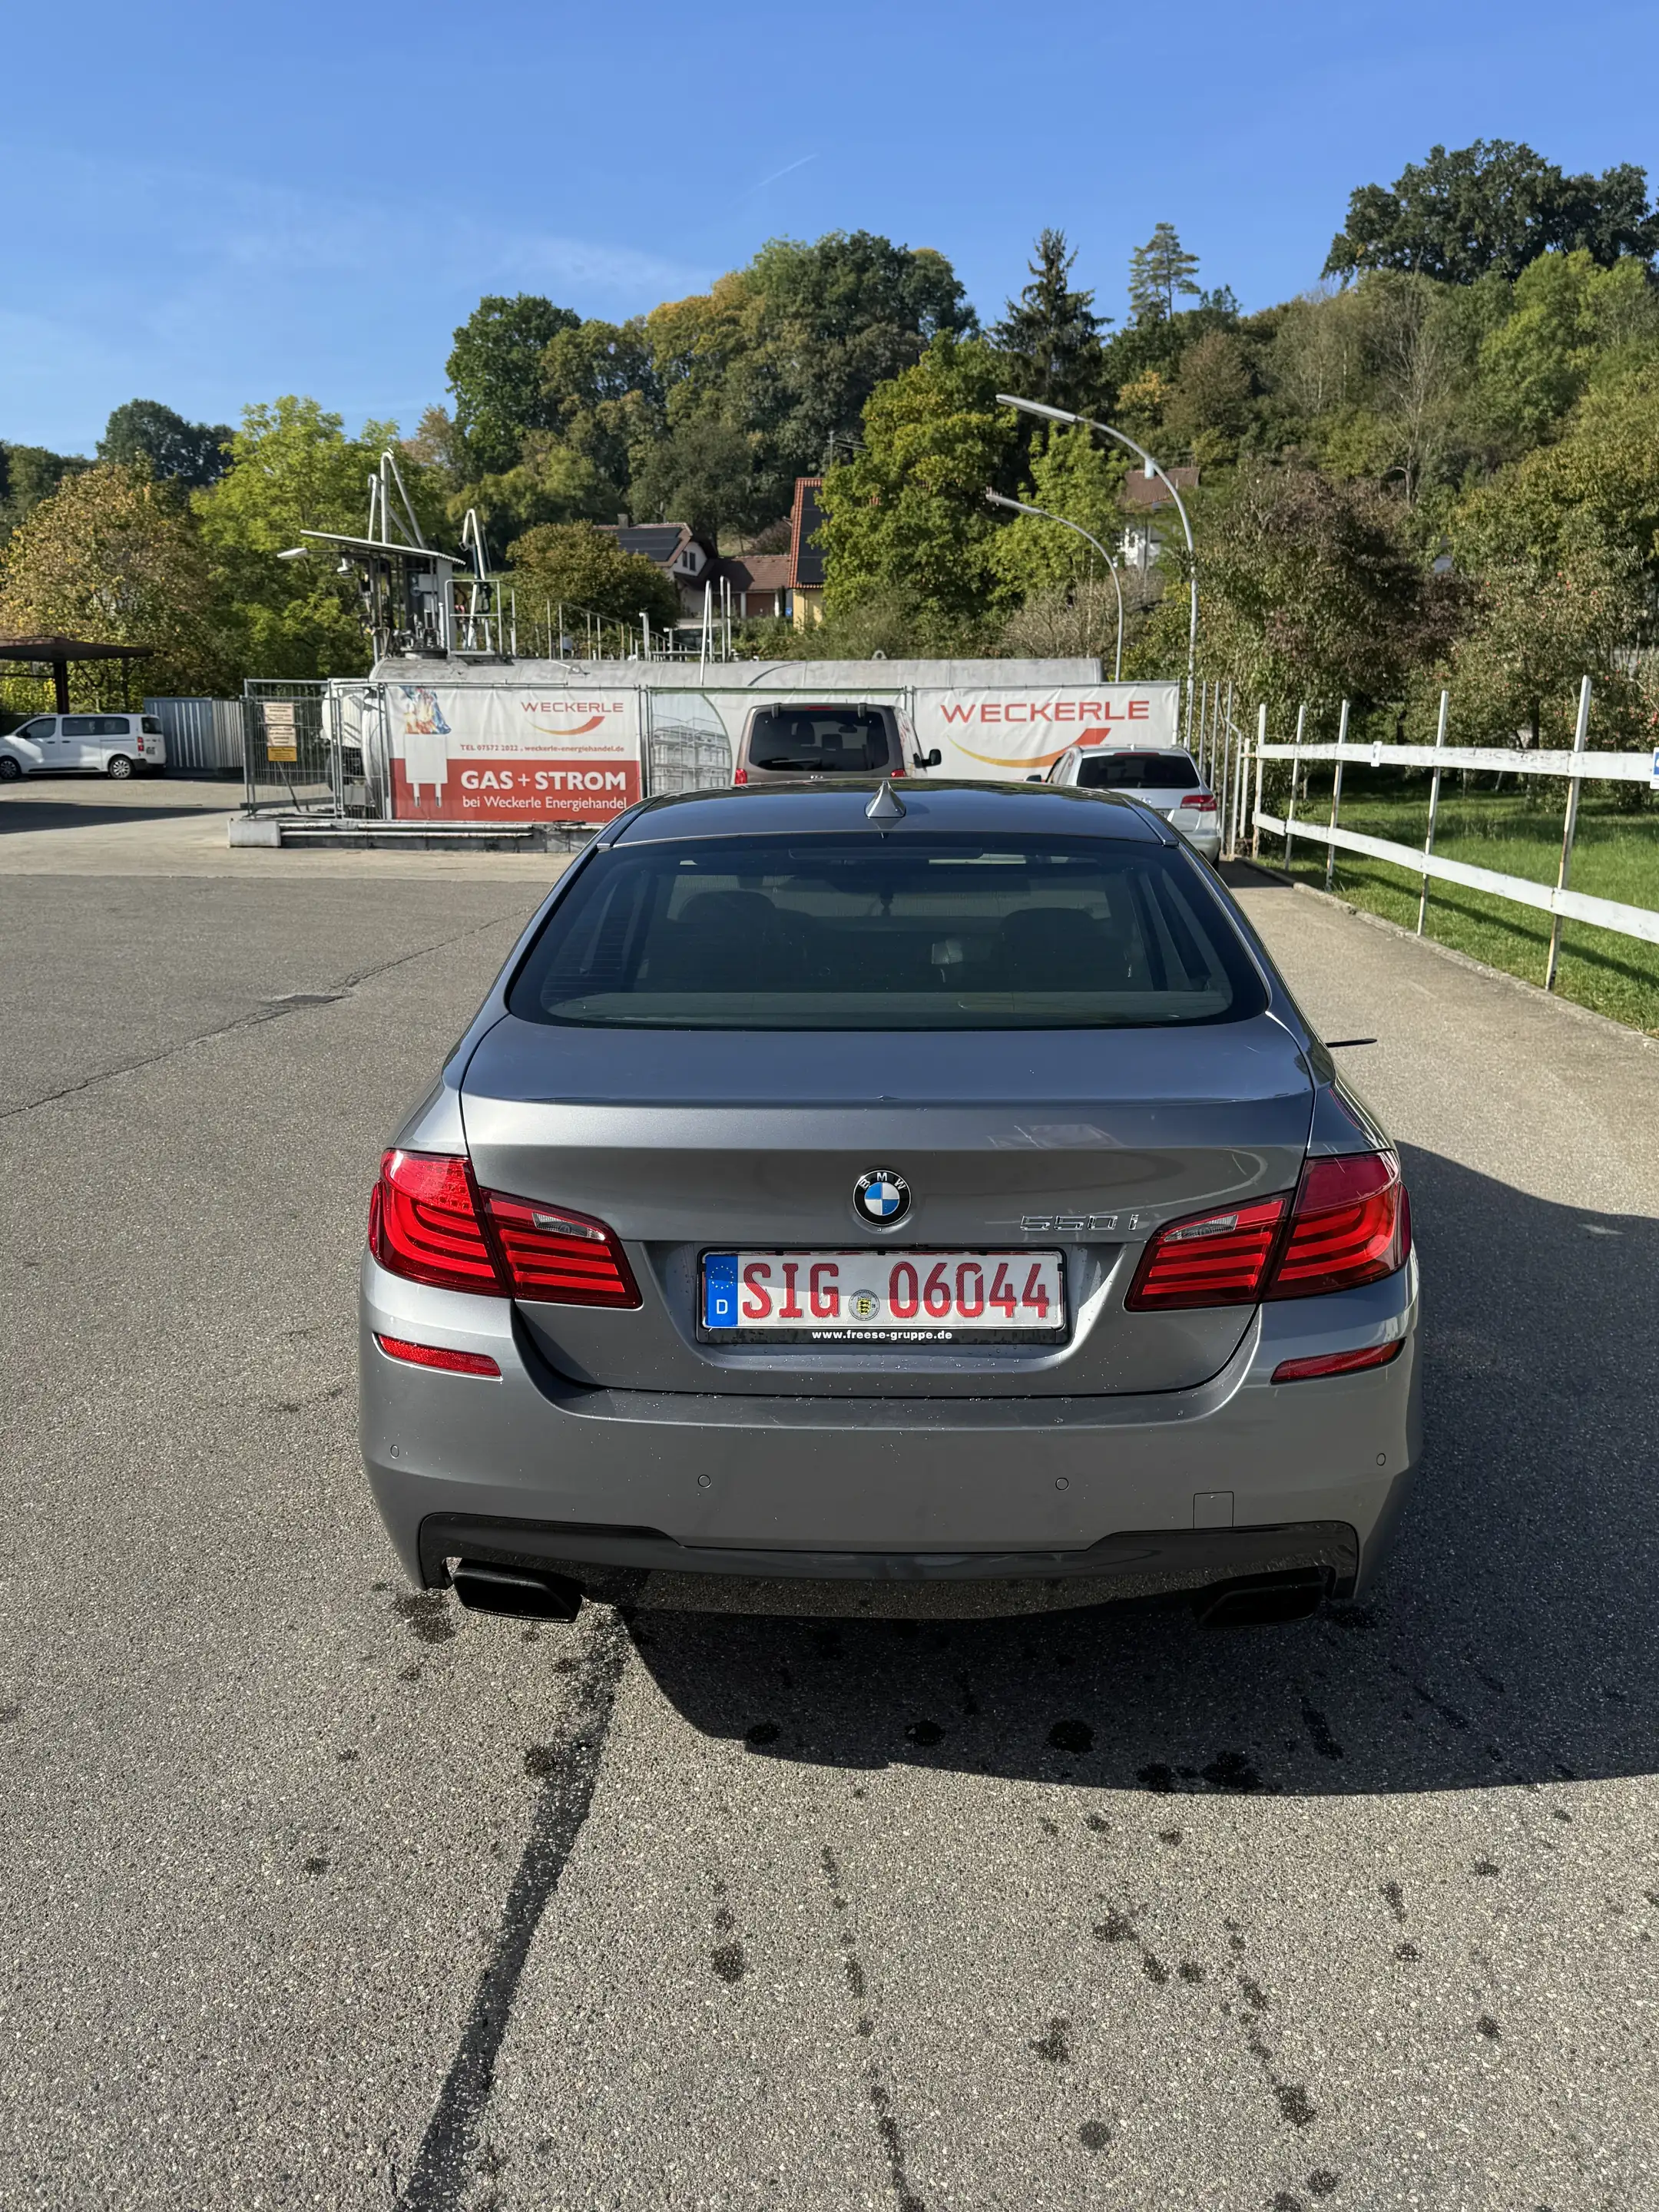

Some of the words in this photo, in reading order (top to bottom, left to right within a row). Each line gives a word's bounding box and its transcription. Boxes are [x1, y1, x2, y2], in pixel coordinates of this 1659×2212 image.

[521, 702, 624, 713] WECKERLE
[940, 700, 1150, 724] WECKERLE
[460, 770, 514, 790] GAS
[518, 773, 531, 786] +
[535, 771, 626, 790] STROM
[462, 796, 480, 807] bei
[484, 796, 541, 809] Weckerle
[545, 796, 627, 812] Energiehandel
[859, 1172, 906, 1190] BMW
[716, 1300, 728, 1314] D
[743, 1263, 839, 1318] SIG
[889, 1261, 1049, 1318] 06044
[812, 1330, 953, 1341] www.freese-gruppe.de
